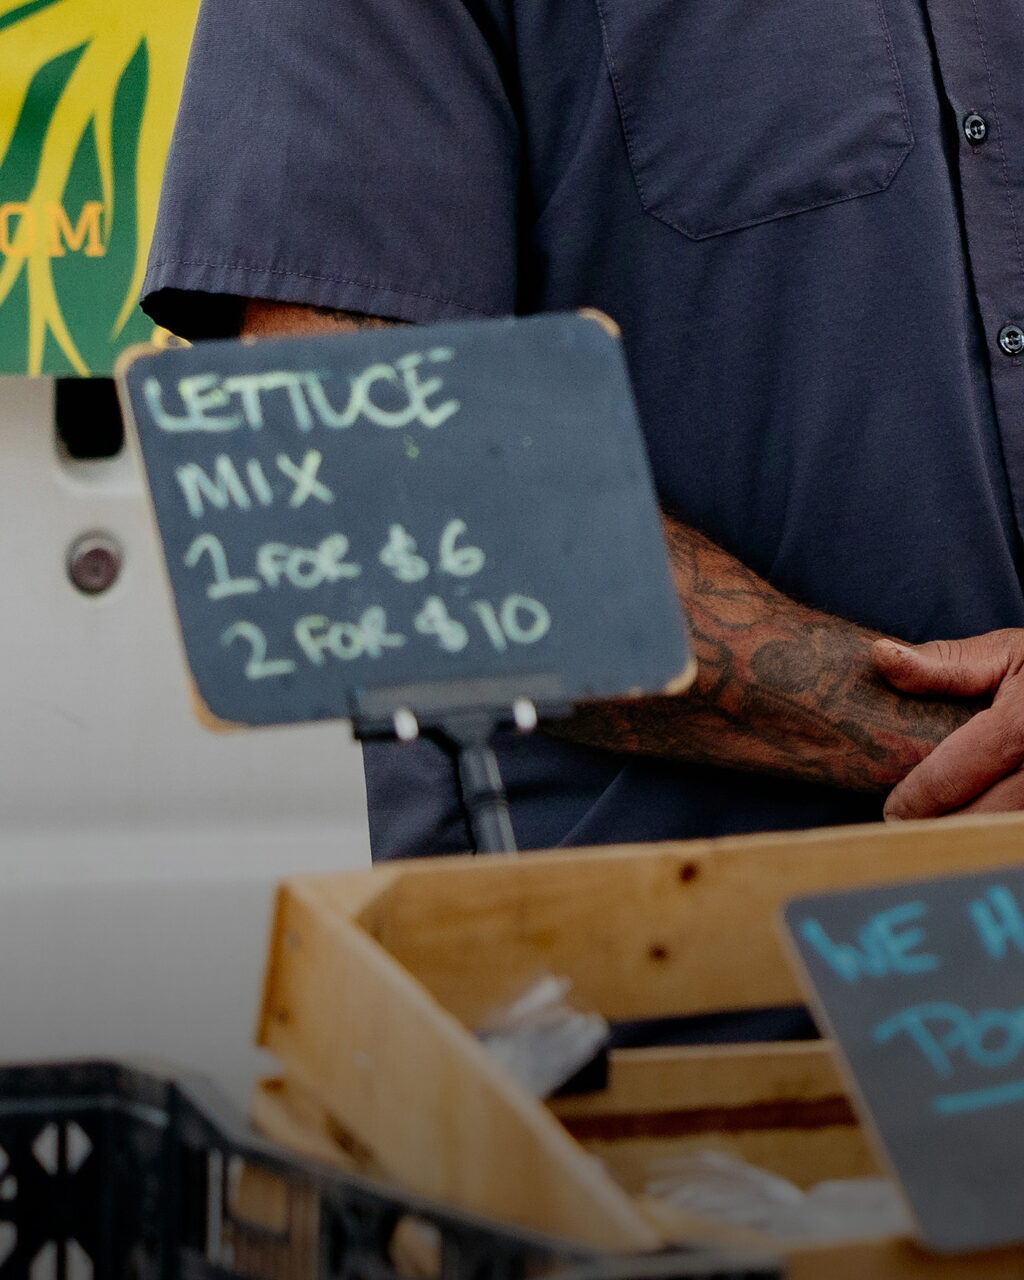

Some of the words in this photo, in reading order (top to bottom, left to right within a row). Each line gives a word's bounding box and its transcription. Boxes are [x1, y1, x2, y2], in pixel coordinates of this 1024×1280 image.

[144, 346, 461, 432] LETTUCE
[174, 448, 335, 519] MIX
[256, 533, 362, 589] FOR
[221, 620, 296, 681] 2
[294, 605, 407, 666] FOR
[801, 900, 942, 984] WE
